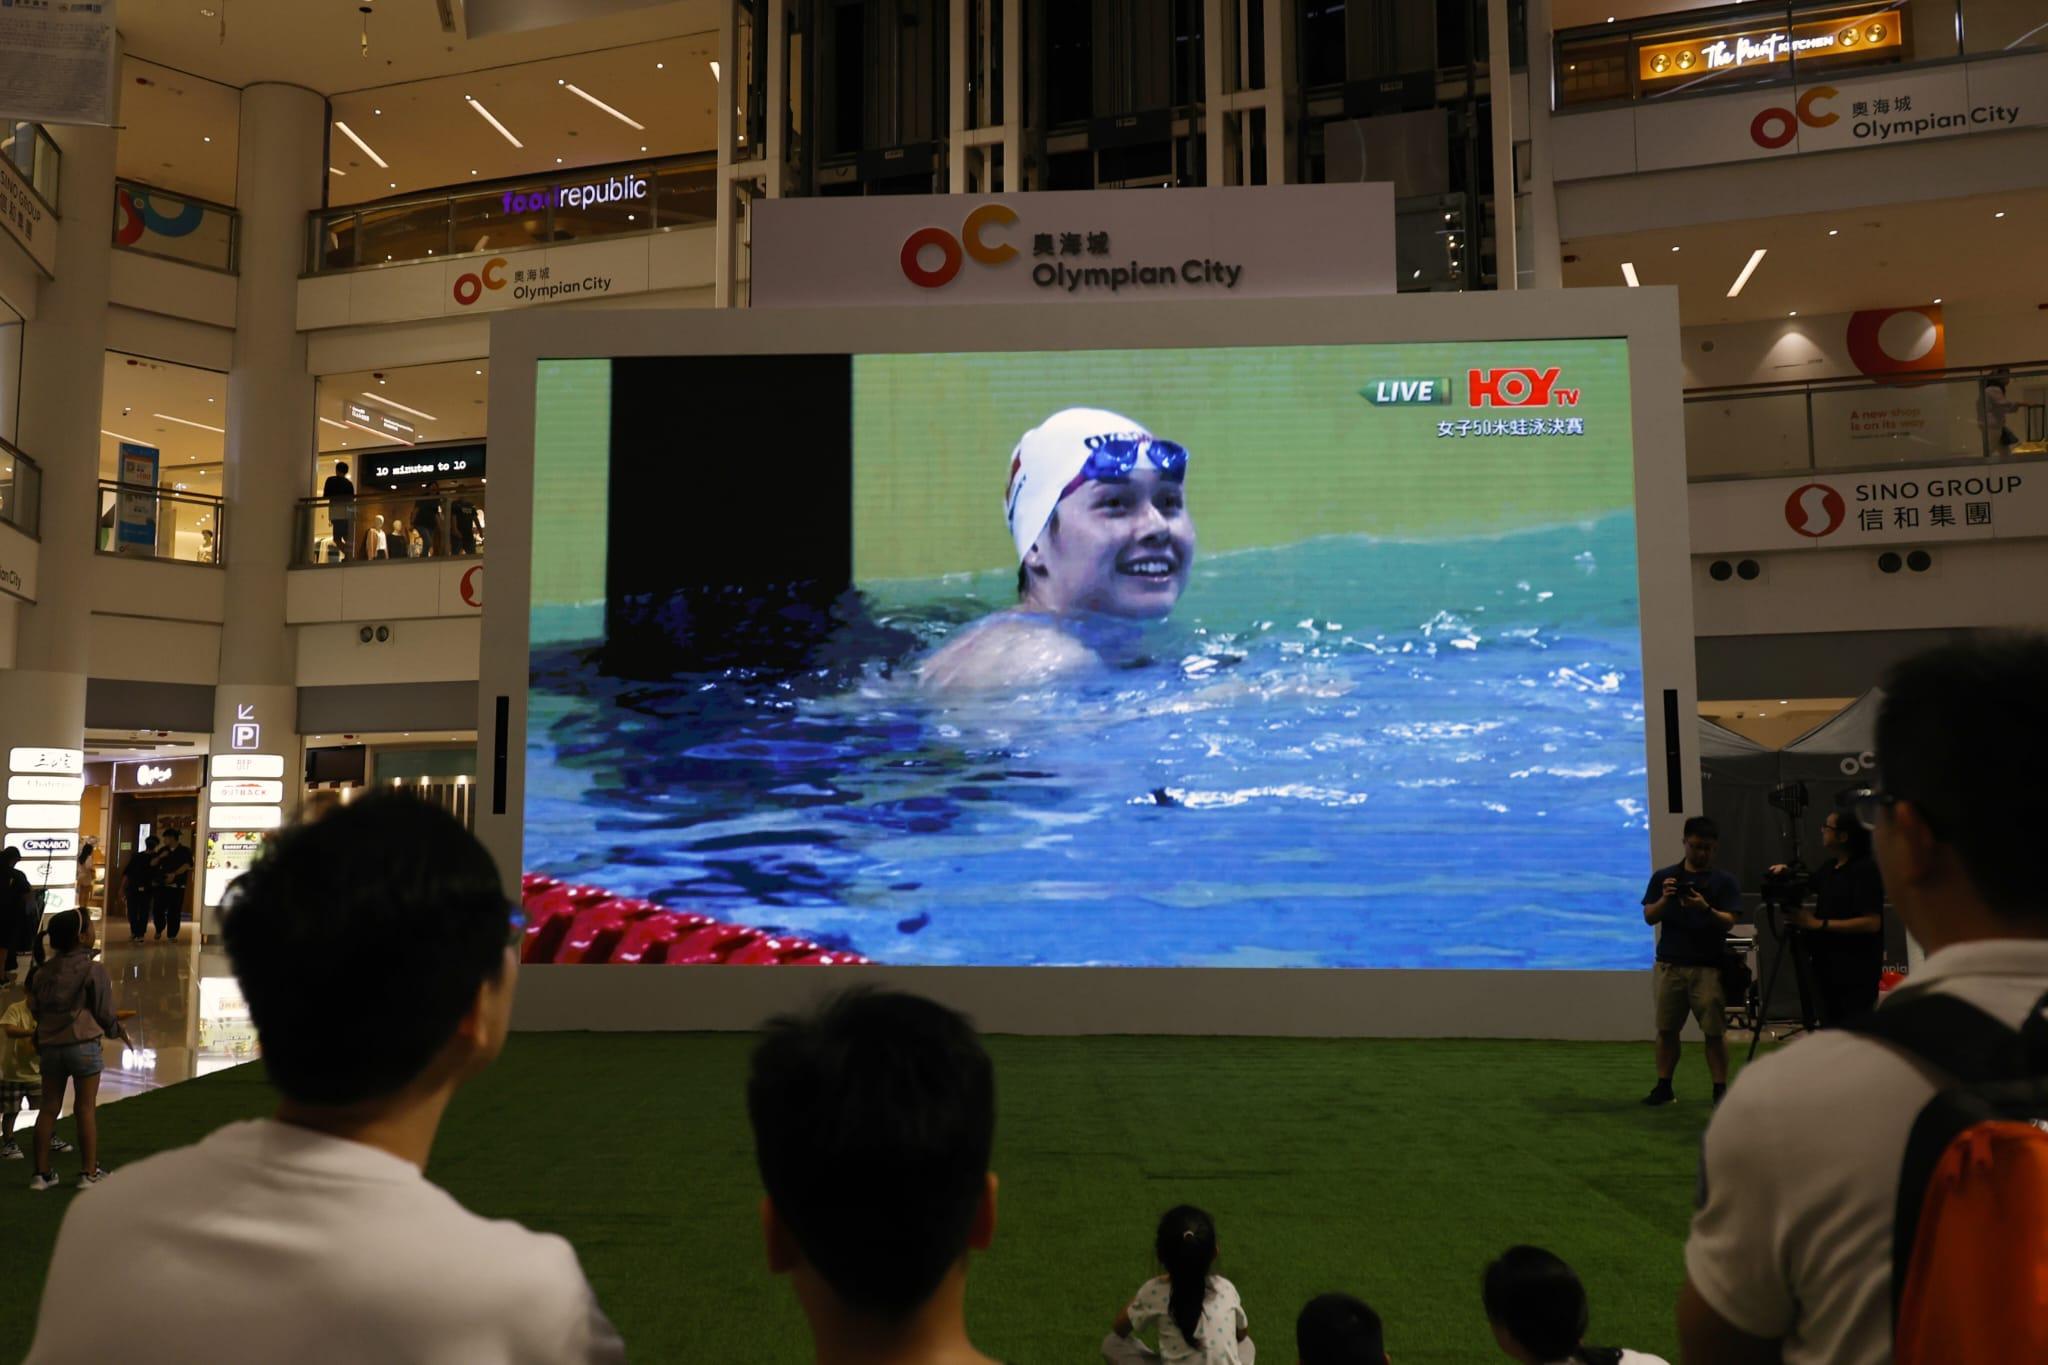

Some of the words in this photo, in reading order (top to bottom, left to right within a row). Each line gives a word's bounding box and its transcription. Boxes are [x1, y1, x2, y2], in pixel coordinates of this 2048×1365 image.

[1701, 41, 1735, 69] The
[1750, 85, 1840, 149] OC
[1852, 96, 1911, 118] 奧海城
[1852, 112, 1966, 139] Olympian
[1970, 104, 2020, 127] City
[900, 203, 1021, 288] OC
[453, 257, 508, 305] OC
[513, 280, 581, 301] Olympian
[582, 274, 612, 292] City
[1032, 260, 1176, 291] Olympian
[1181, 259, 1241, 288] City
[1376, 381, 1435, 403] LIVE
[1553, 389, 1580, 407] TV
[1862, 410, 1887, 419] new
[1863, 422, 1880, 431] on
[376, 467, 389, 477] 10
[392, 463, 435, 475] minutes
[437, 462, 450, 471] to
[453, 460, 466, 470] 10
[1855, 482, 1919, 502] SINO
[1926, 476, 2022, 498] GROUP
[1857, 501, 1992, 532] 信和集團
[236, 726, 254, 747] P
[25, 839, 70, 849] CINNABON
